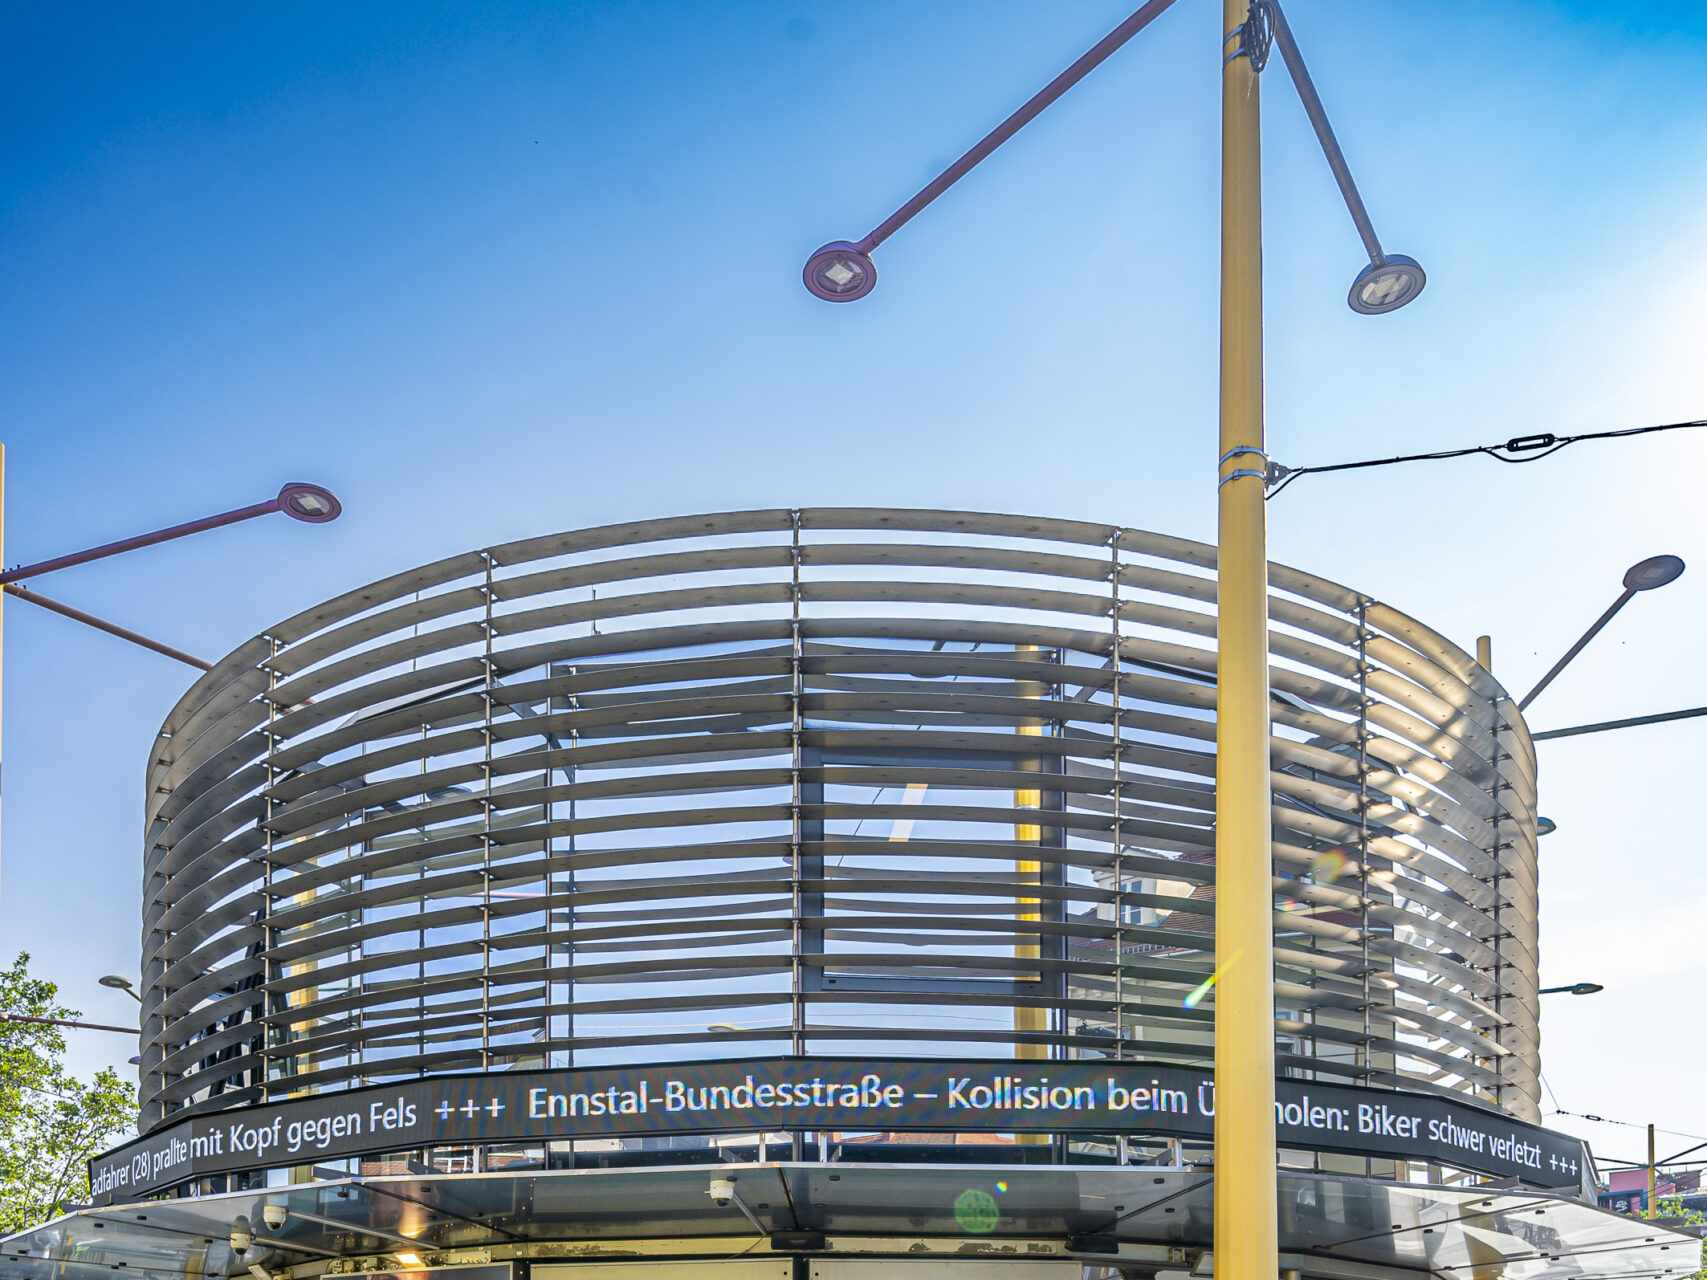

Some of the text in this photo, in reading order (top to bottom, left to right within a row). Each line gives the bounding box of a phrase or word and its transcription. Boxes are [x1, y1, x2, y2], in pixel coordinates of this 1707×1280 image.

[92, 1163, 130, 1196] adfahrer
[132, 1151, 150, 1186] (28)
[153, 1137, 187, 1180] prallte
[190, 1127, 223, 1158] mit
[230, 1116, 282, 1157] Kopf
[287, 1113, 361, 1153] gegen
[369, 1096, 417, 1132] Fels
[528, 1074, 903, 1119] Ennstal-Bundesstraße
[947, 1076, 1095, 1109] Kollision
[1107, 1078, 1188, 1114] beim
[1358, 1104, 1421, 1138] Biker
[1428, 1115, 1486, 1152] schwer
[1488, 1134, 1542, 1169] verletzt
